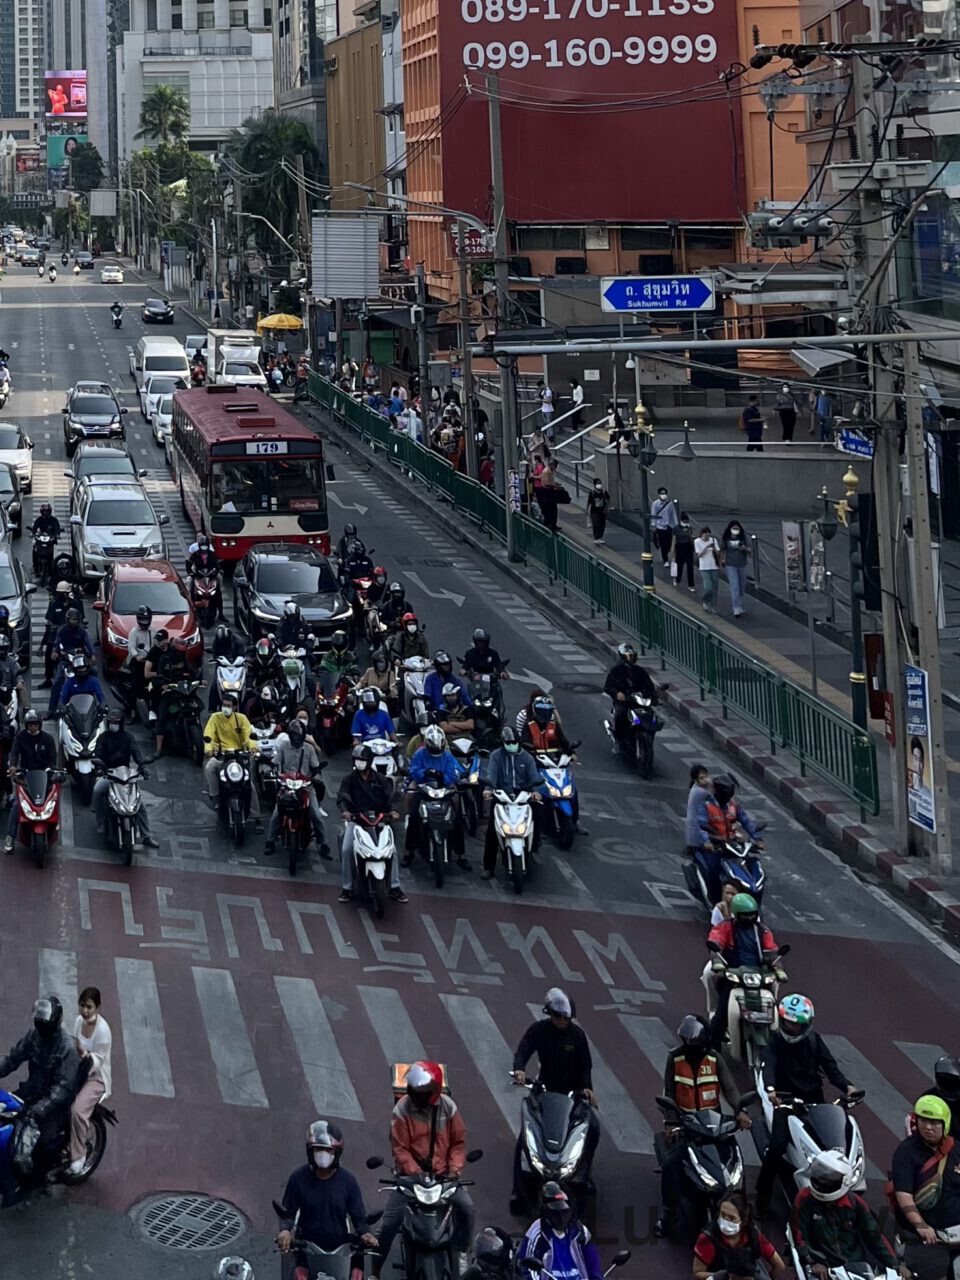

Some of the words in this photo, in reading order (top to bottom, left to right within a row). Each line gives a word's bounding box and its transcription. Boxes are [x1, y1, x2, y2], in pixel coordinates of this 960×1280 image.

[463, 34, 718, 70] 099-160-9999
[643, 280, 690, 299] สุขุมวิท
[627, 300, 669, 308] Sukhumvit
[255, 442, 280, 453] 179
